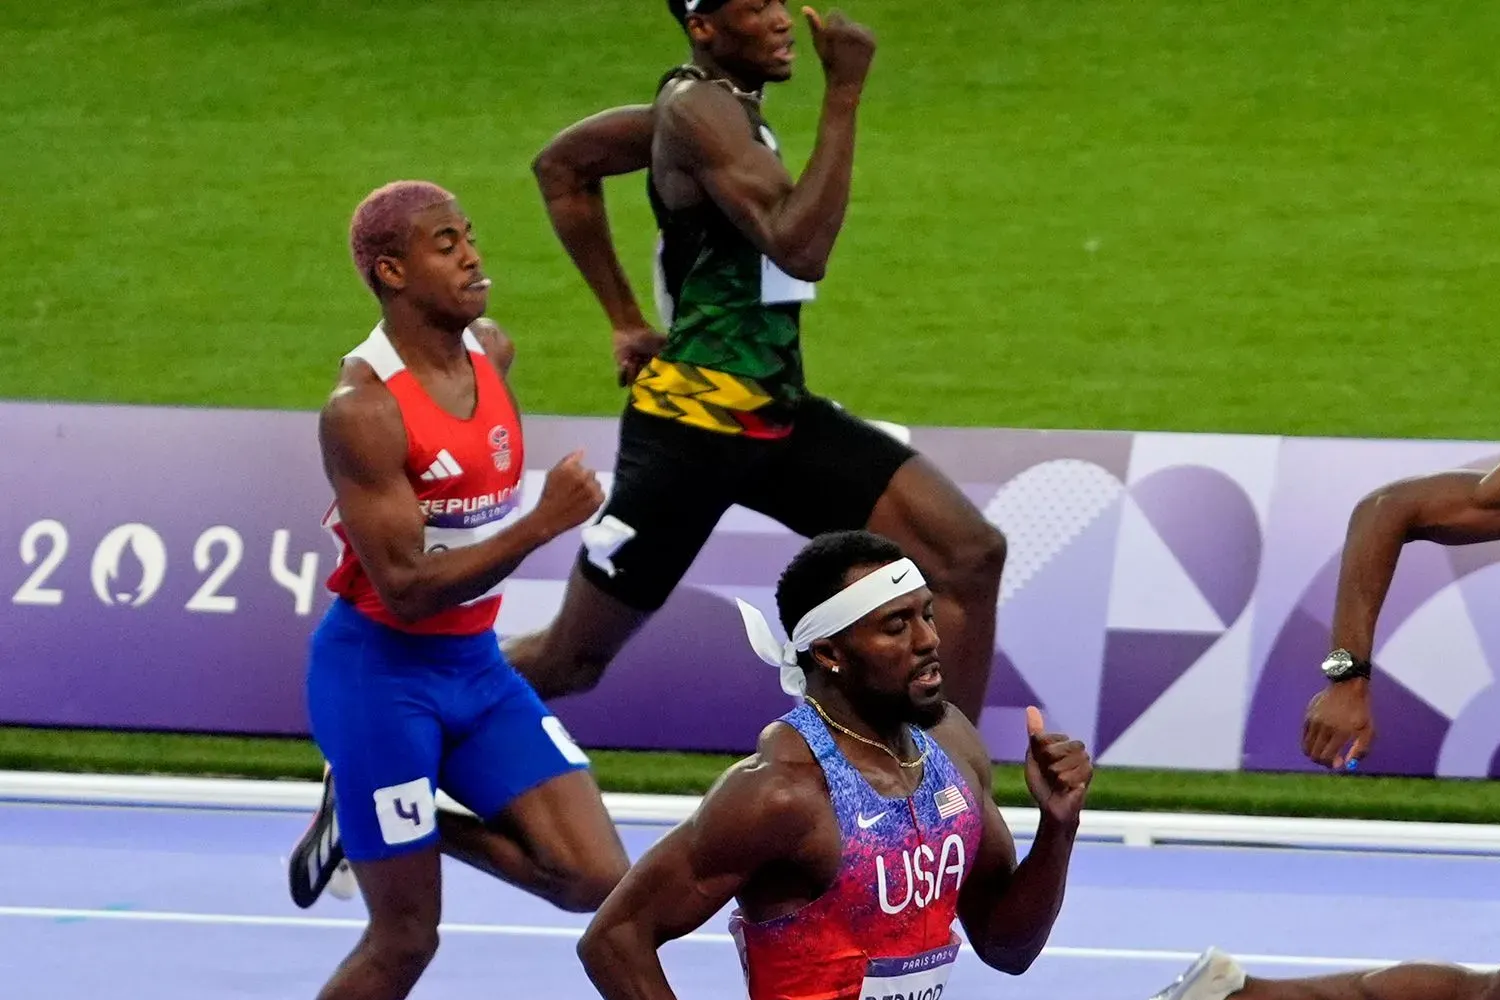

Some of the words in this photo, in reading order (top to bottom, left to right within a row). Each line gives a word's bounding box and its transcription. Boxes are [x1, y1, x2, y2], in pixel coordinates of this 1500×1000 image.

[13, 519, 319, 615] 2024
[393, 797, 421, 826] 4
[876, 834, 965, 914] USA
[902, 956, 929, 970] PARIS
